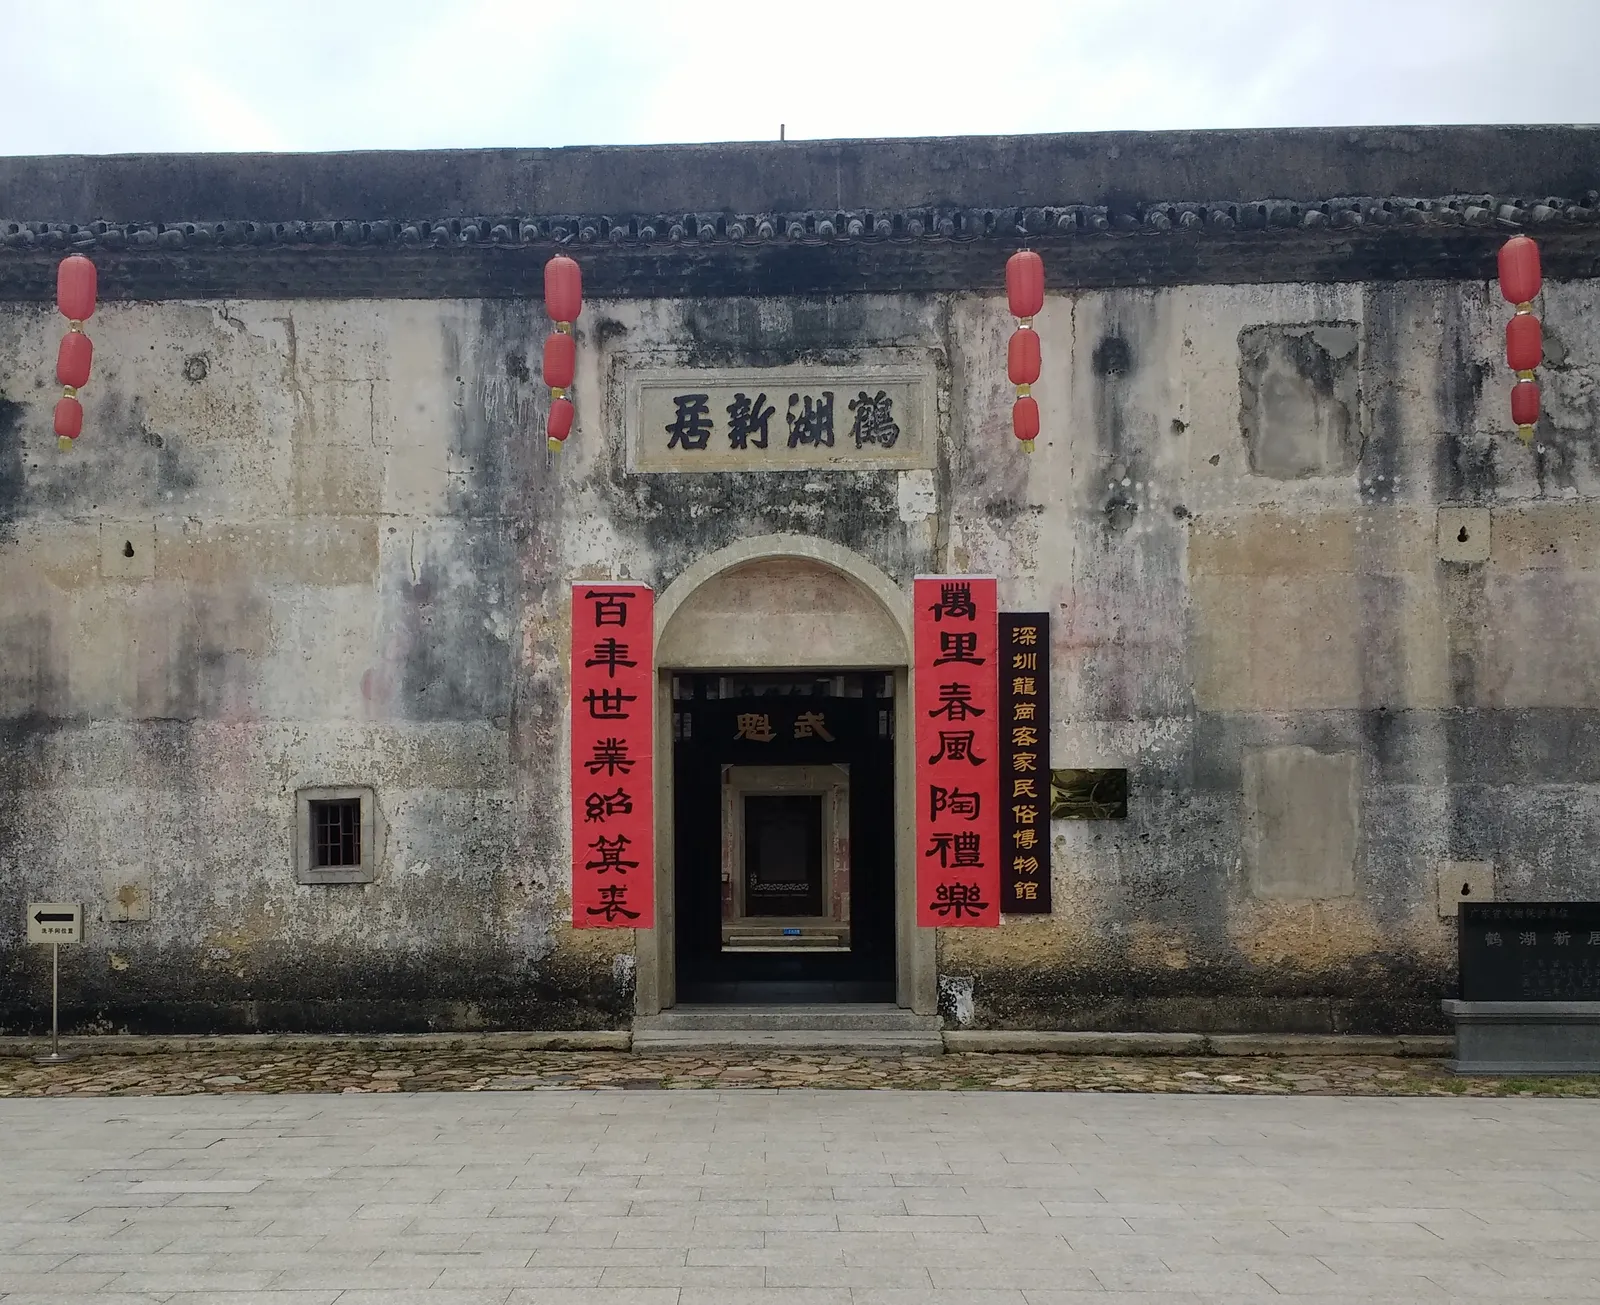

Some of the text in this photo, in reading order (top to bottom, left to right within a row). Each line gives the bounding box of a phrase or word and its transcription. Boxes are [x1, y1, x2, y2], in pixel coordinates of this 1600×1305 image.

[665, 390, 900, 449] 鶴湖新居
[926, 583, 989, 918] 萬里春風陶禮樂
[1011, 626, 1039, 900] 深圳龍崗客家民俗博物館
